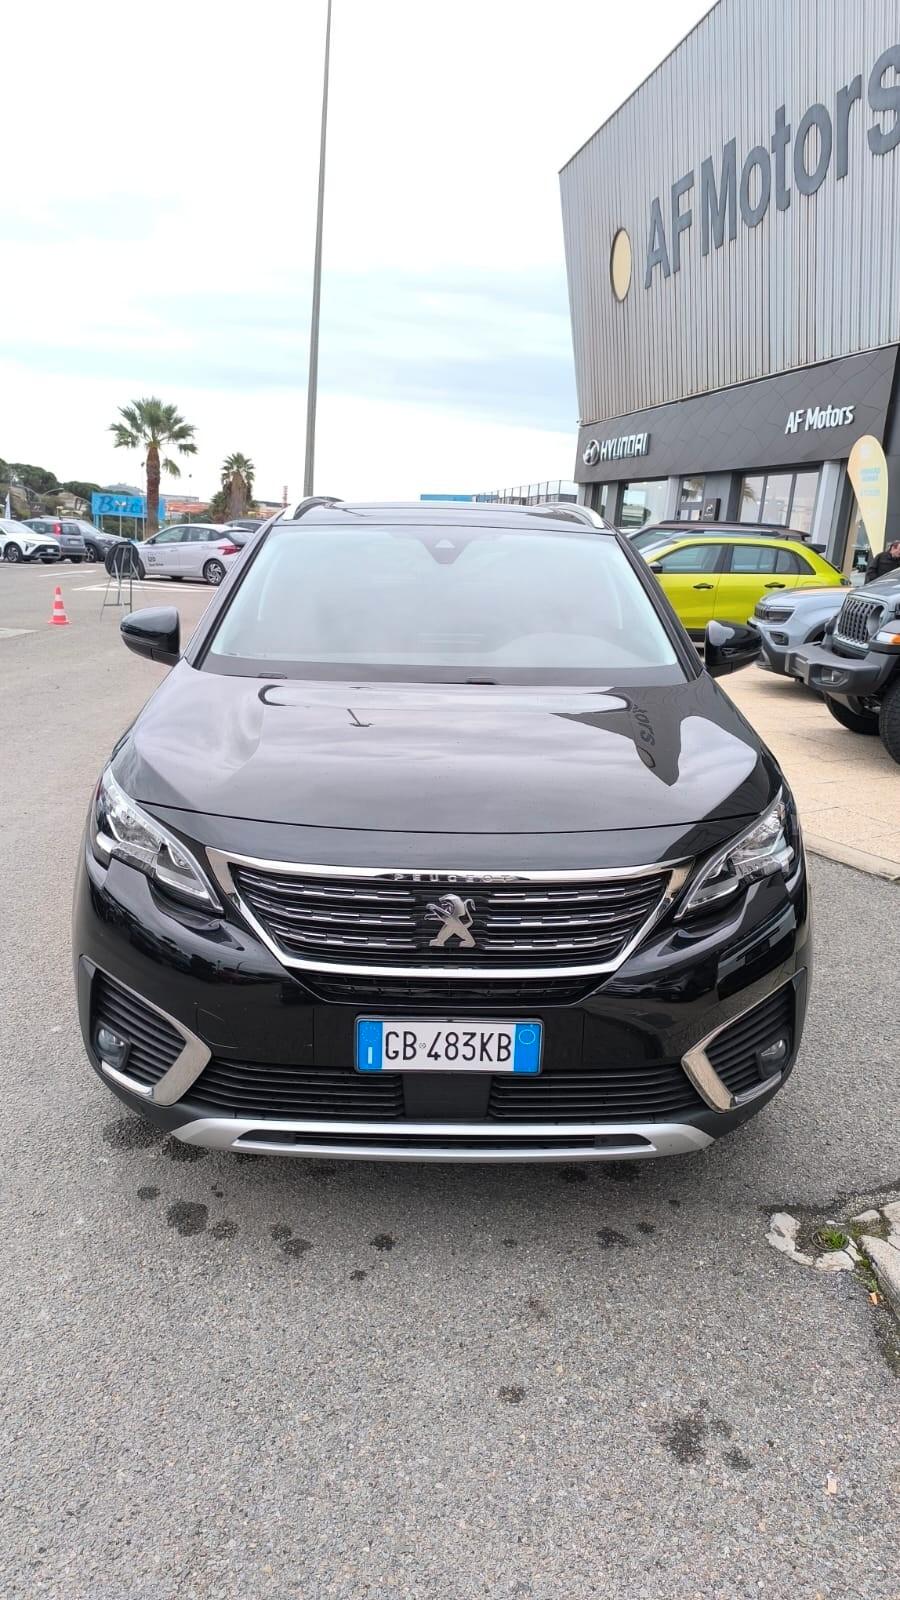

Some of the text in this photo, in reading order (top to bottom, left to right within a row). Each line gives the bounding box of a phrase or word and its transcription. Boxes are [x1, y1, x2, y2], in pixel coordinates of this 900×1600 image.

[645, 44, 900, 290] AF Motors
[784, 404, 855, 435] AF Motors
[600, 433, 649, 462] HYUNDAI
[393, 872, 513, 883] PEUGEOT
